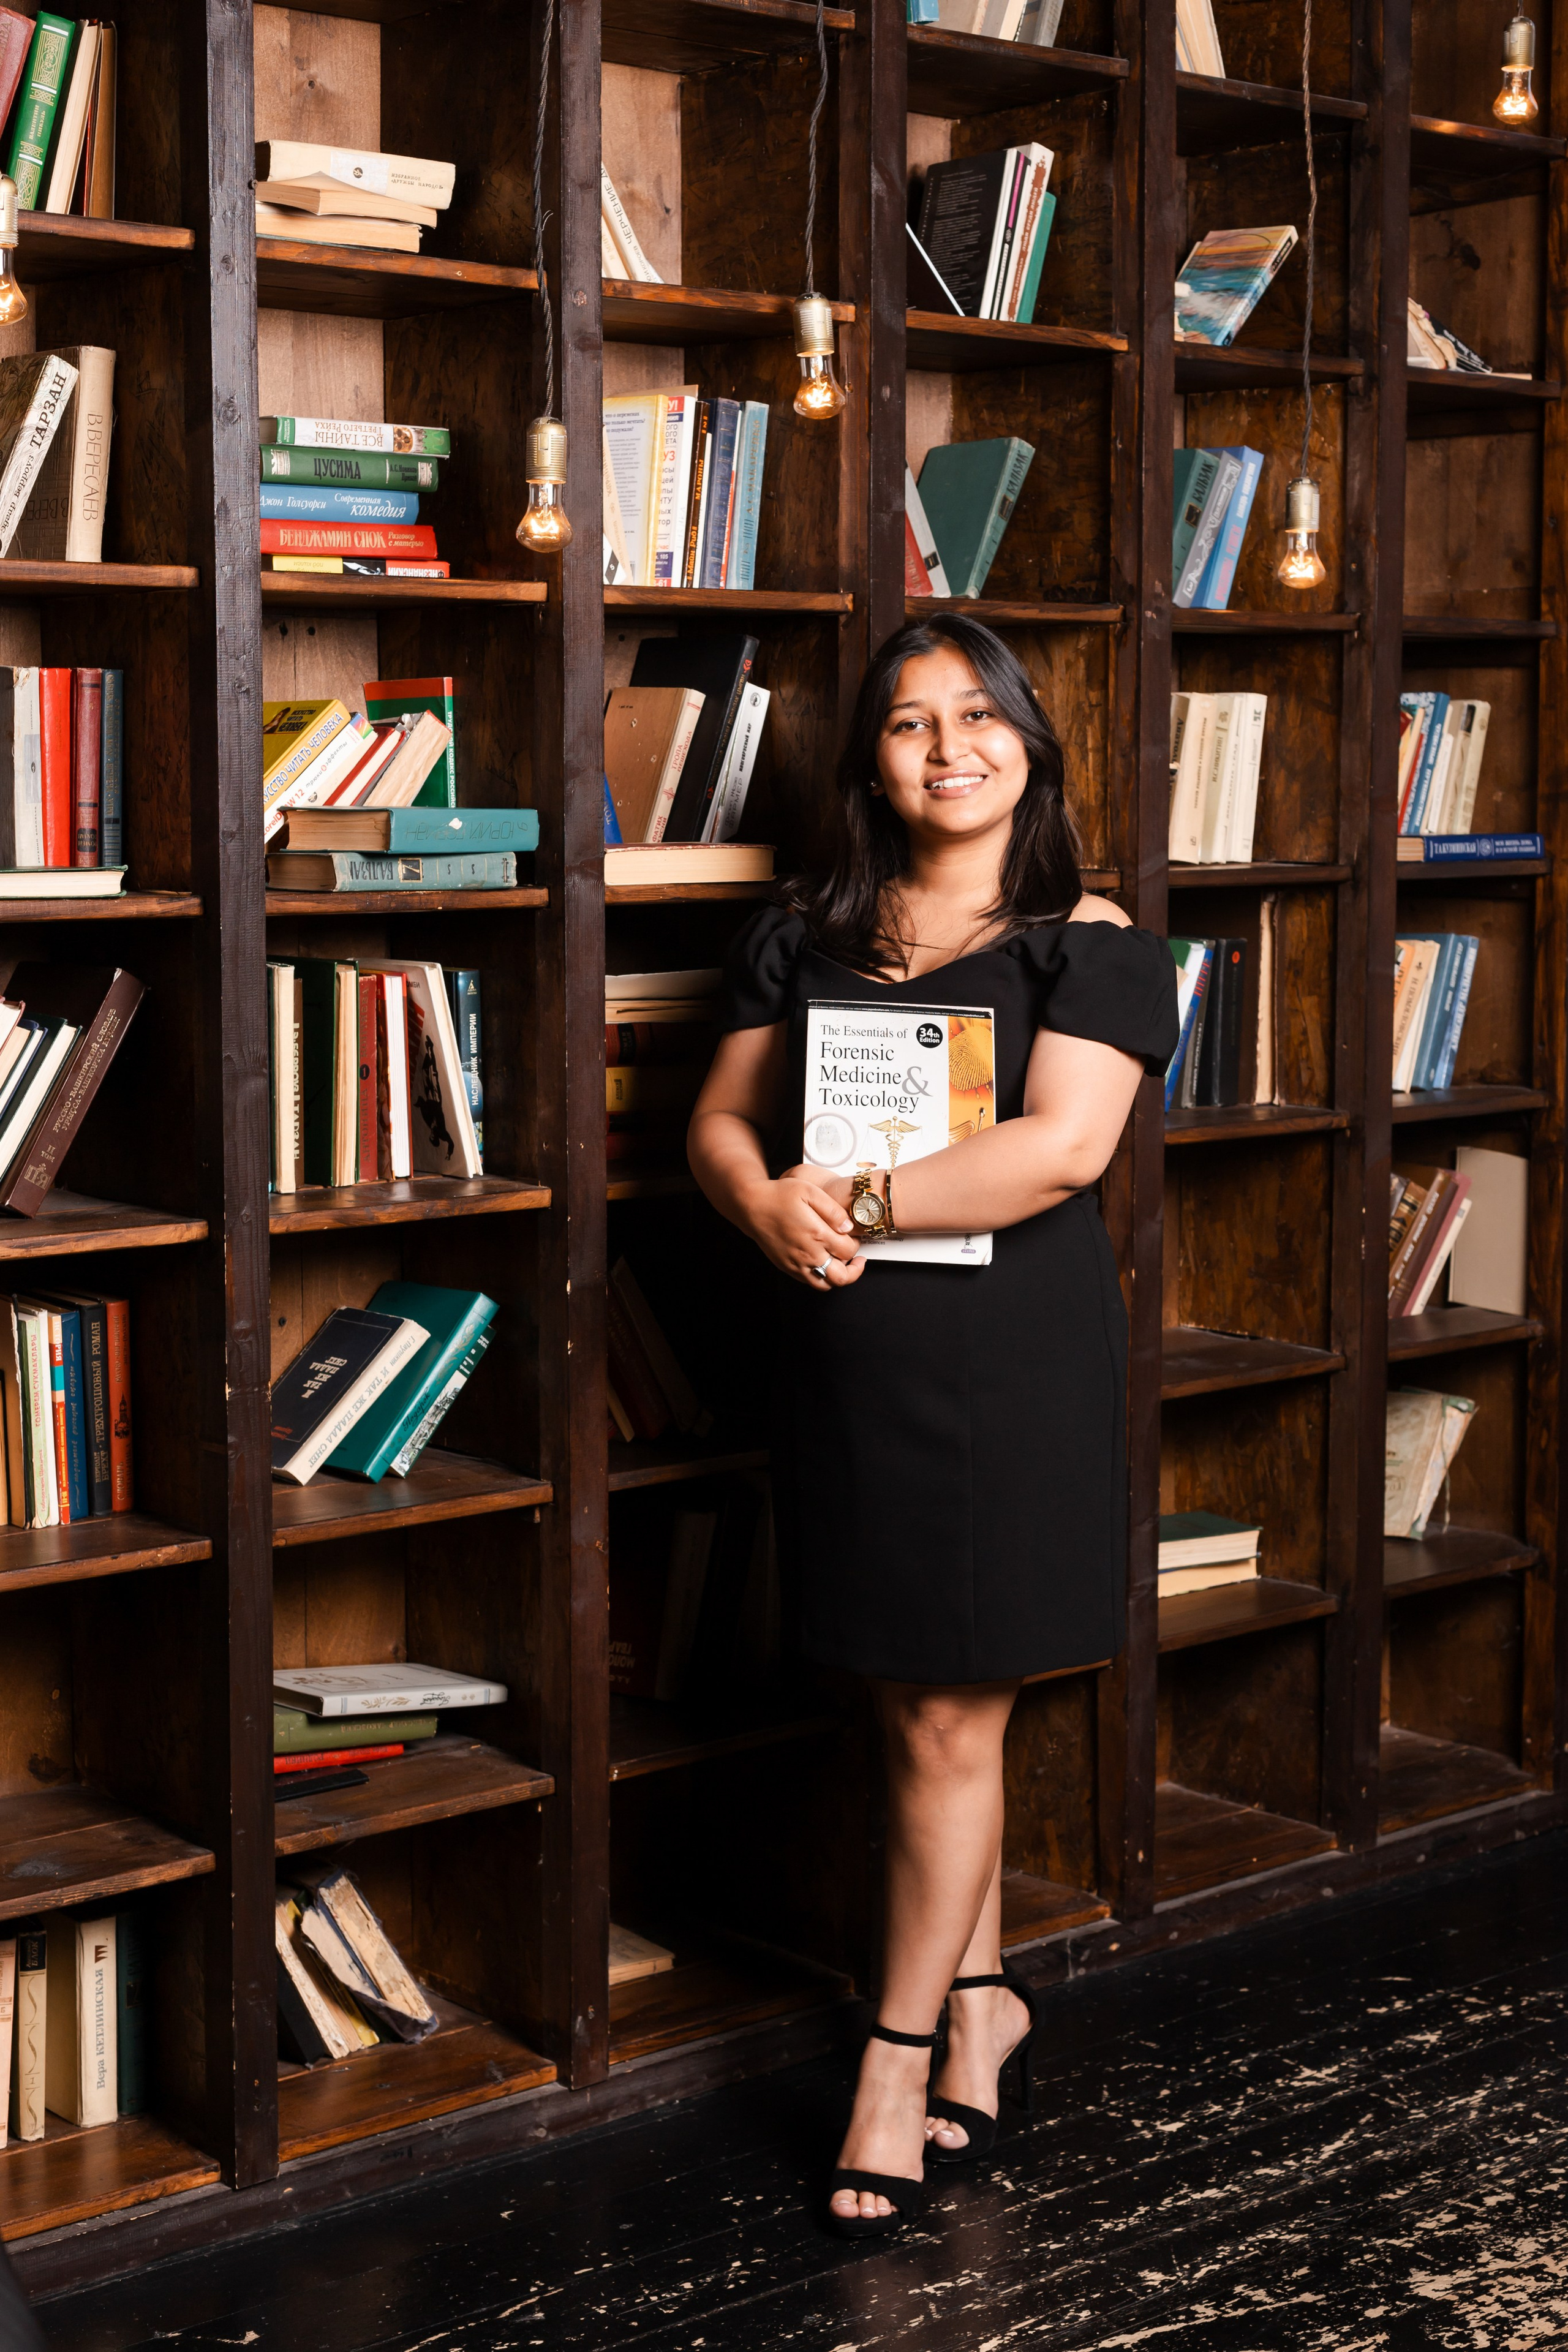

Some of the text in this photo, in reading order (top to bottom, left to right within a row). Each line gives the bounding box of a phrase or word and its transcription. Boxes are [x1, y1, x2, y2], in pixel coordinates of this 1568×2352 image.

[29, 104, 40, 140] ВАЛЕНТИН
[605, 183, 632, 244] ЧЕРЧЕНИЕ
[14, 454, 35, 498] Берроуз
[30, 371, 67, 450] ТАРЗАН
[315, 431, 383, 447] ВСЕ ТАЙНЫ
[314, 458, 361, 480] ЦУСИМА
[1192, 459, 1215, 503] БАЛЬЗАК
[259, 494, 326, 510] Джон Голсуорси
[334, 492, 381, 505] Современная
[350, 500, 407, 518] комедия
[687, 549, 695, 573] Майн
[695, 459, 704, 500] МАРОНЫ
[279, 529, 387, 549] БЕНДЖАМИН СПОК
[388, 532, 415, 541] Разговор
[394, 539, 424, 548] матерью
[285, 744, 312, 777] ЧИТАТЬ
[308, 712, 344, 748] ЧЕЛОВЕКА
[671, 744, 683, 770] ТРОПА
[677, 731, 693, 772] ПЕШЕХОДА
[294, 788, 305, 800] 12
[468, 820, 516, 840] ЮРИЙ
[652, 815, 663, 842] ФАТИХ
[97, 1008, 118, 1042] СЛОВАРЬ
[821, 1025, 908, 1038] The Essentials of
[919, 1027, 941, 1038] 34th
[821, 1041, 895, 1061] Forensic
[471, 1056, 480, 1106] НАСЛЕДНИК
[820, 1065, 933, 1097] Medicine &
[819, 1088, 919, 1114] Toxicology
[360, 1088, 370, 1162] АНТОНИНА
[40, 1151, 56, 1163] ТОМ
[53, 1321, 62, 1362] ИСТОРИЯ
[91, 1321, 105, 1444] ТРЕХГРОШОВЫЙ РОМАН
[366, 1376, 383, 1396] ТАК
[352, 1395, 368, 1412] ЖЕ
[325, 1409, 355, 1443] ПАДАЛ
[100, 1450, 110, 1481] БРЕХТ
[307, 1443, 328, 1468] СНЕГ
[95, 1967, 106, 2089] Вера КЕТЛИНСКАЯ
